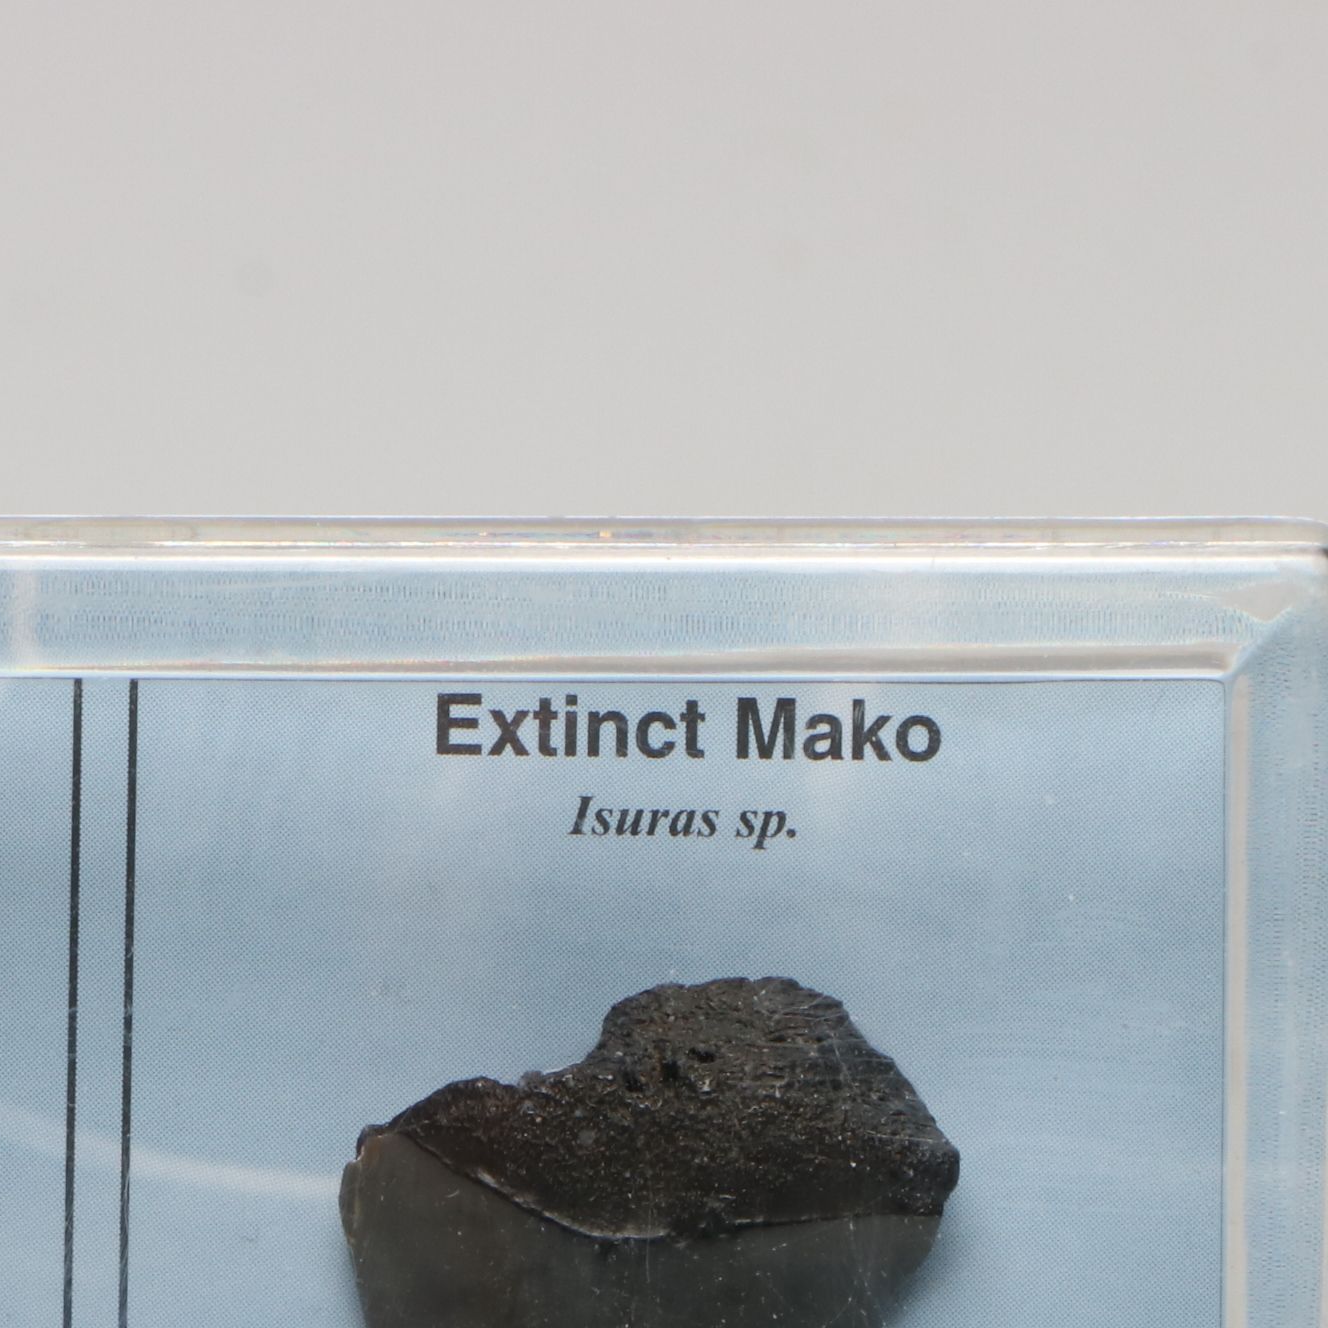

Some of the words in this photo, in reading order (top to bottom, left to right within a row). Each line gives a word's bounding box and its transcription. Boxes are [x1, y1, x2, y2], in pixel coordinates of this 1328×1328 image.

[436, 692, 706, 759] Extinct
[736, 696, 942, 763] Mako
[568, 795, 719, 839] Isuras
[735, 810, 797, 851] sp.
